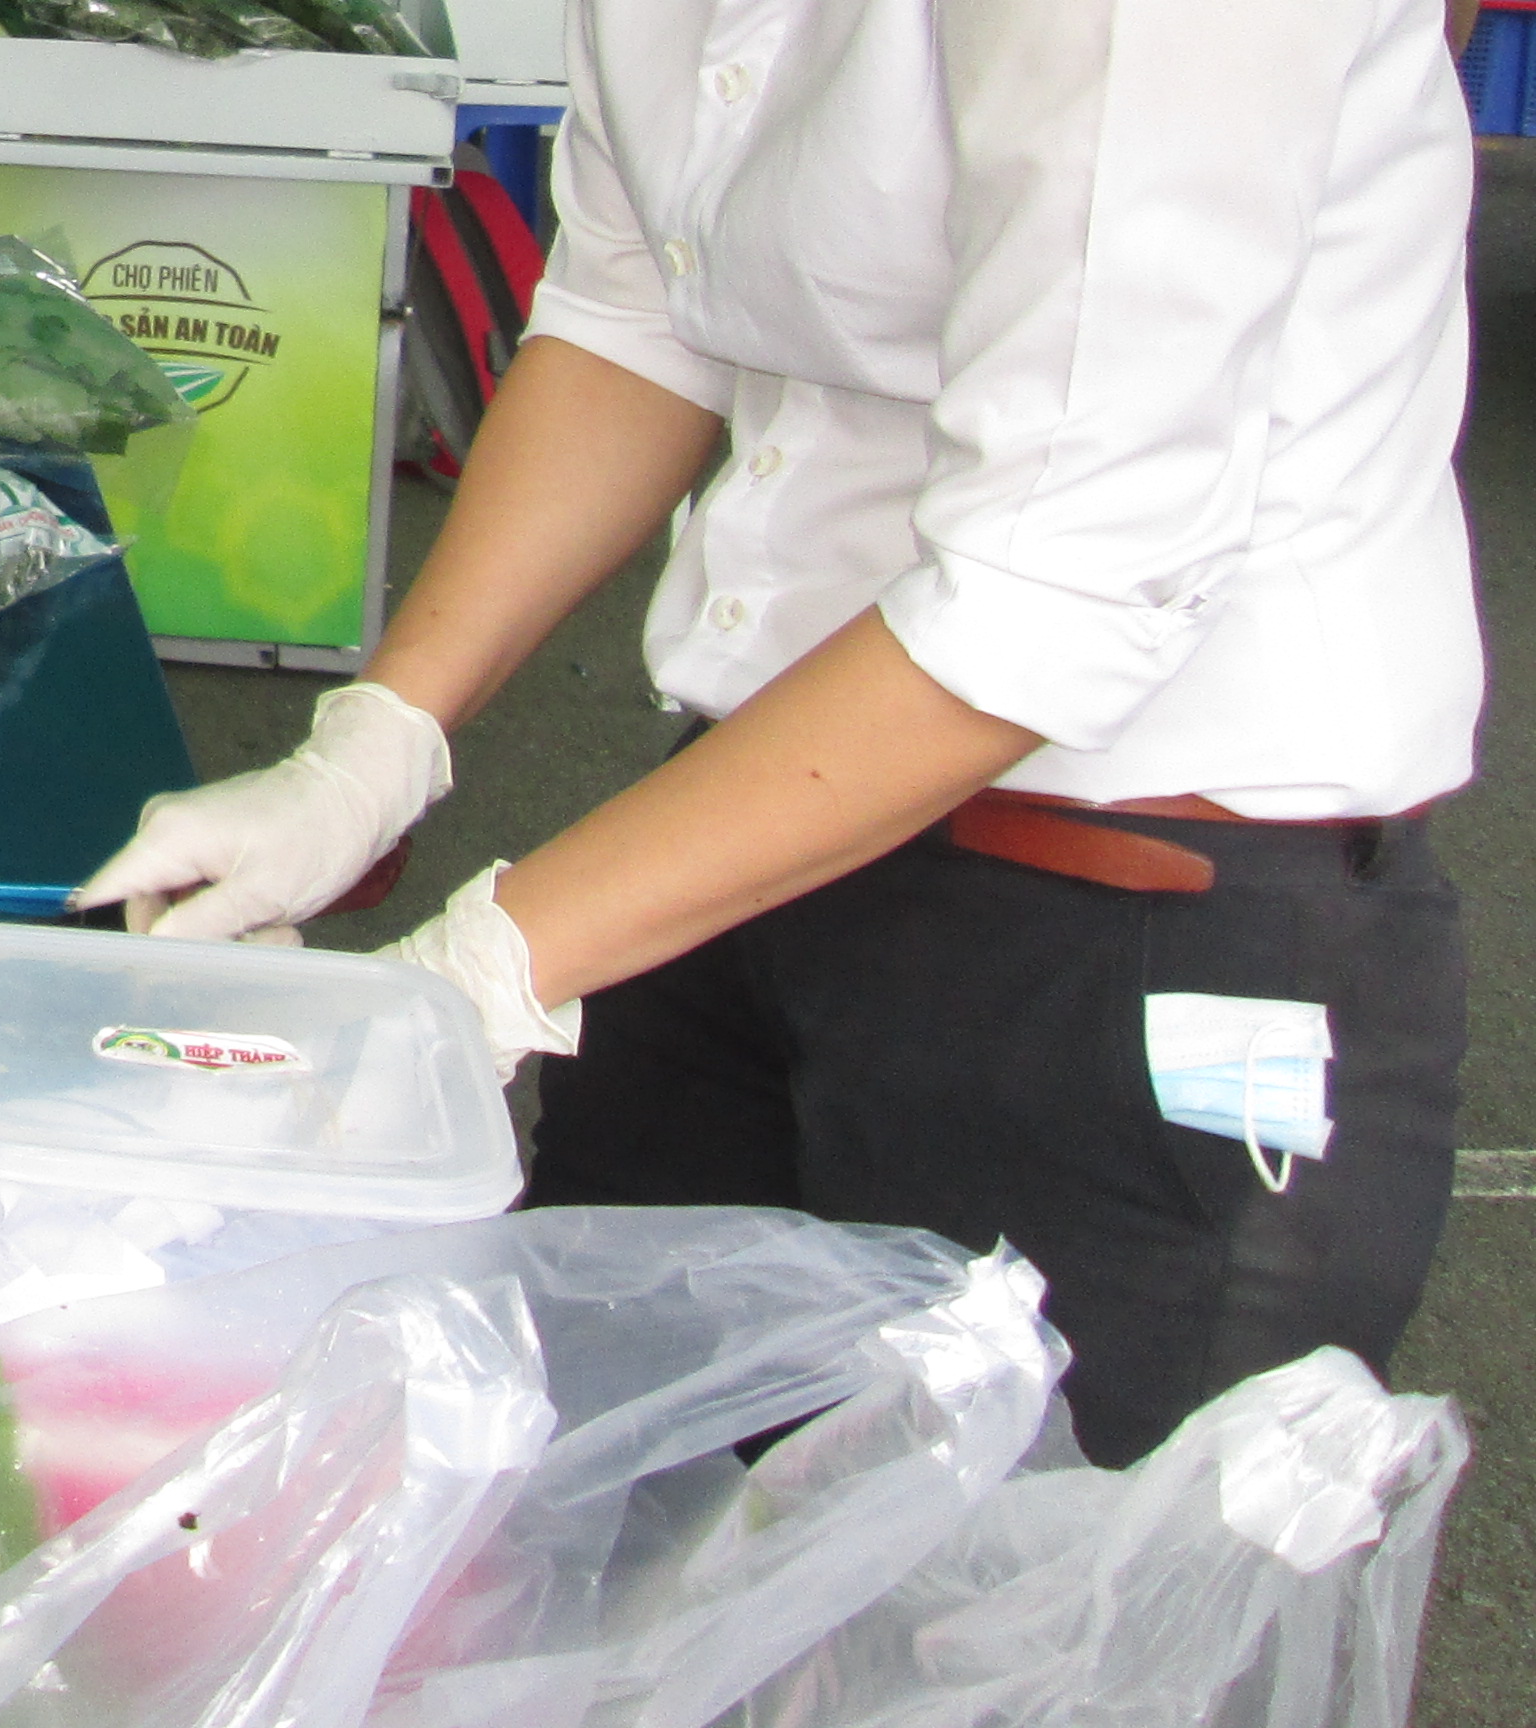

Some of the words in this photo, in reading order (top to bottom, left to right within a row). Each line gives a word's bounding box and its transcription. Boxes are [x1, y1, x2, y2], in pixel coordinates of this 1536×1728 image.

[113, 262, 152, 292] CHỢ
[158, 263, 220, 293] PHIÊN
[119, 306, 170, 340] SẢN
[174, 316, 210, 343] AN
[215, 321, 282, 358] TOÀN
[184, 1042, 224, 1063] HIỆP
